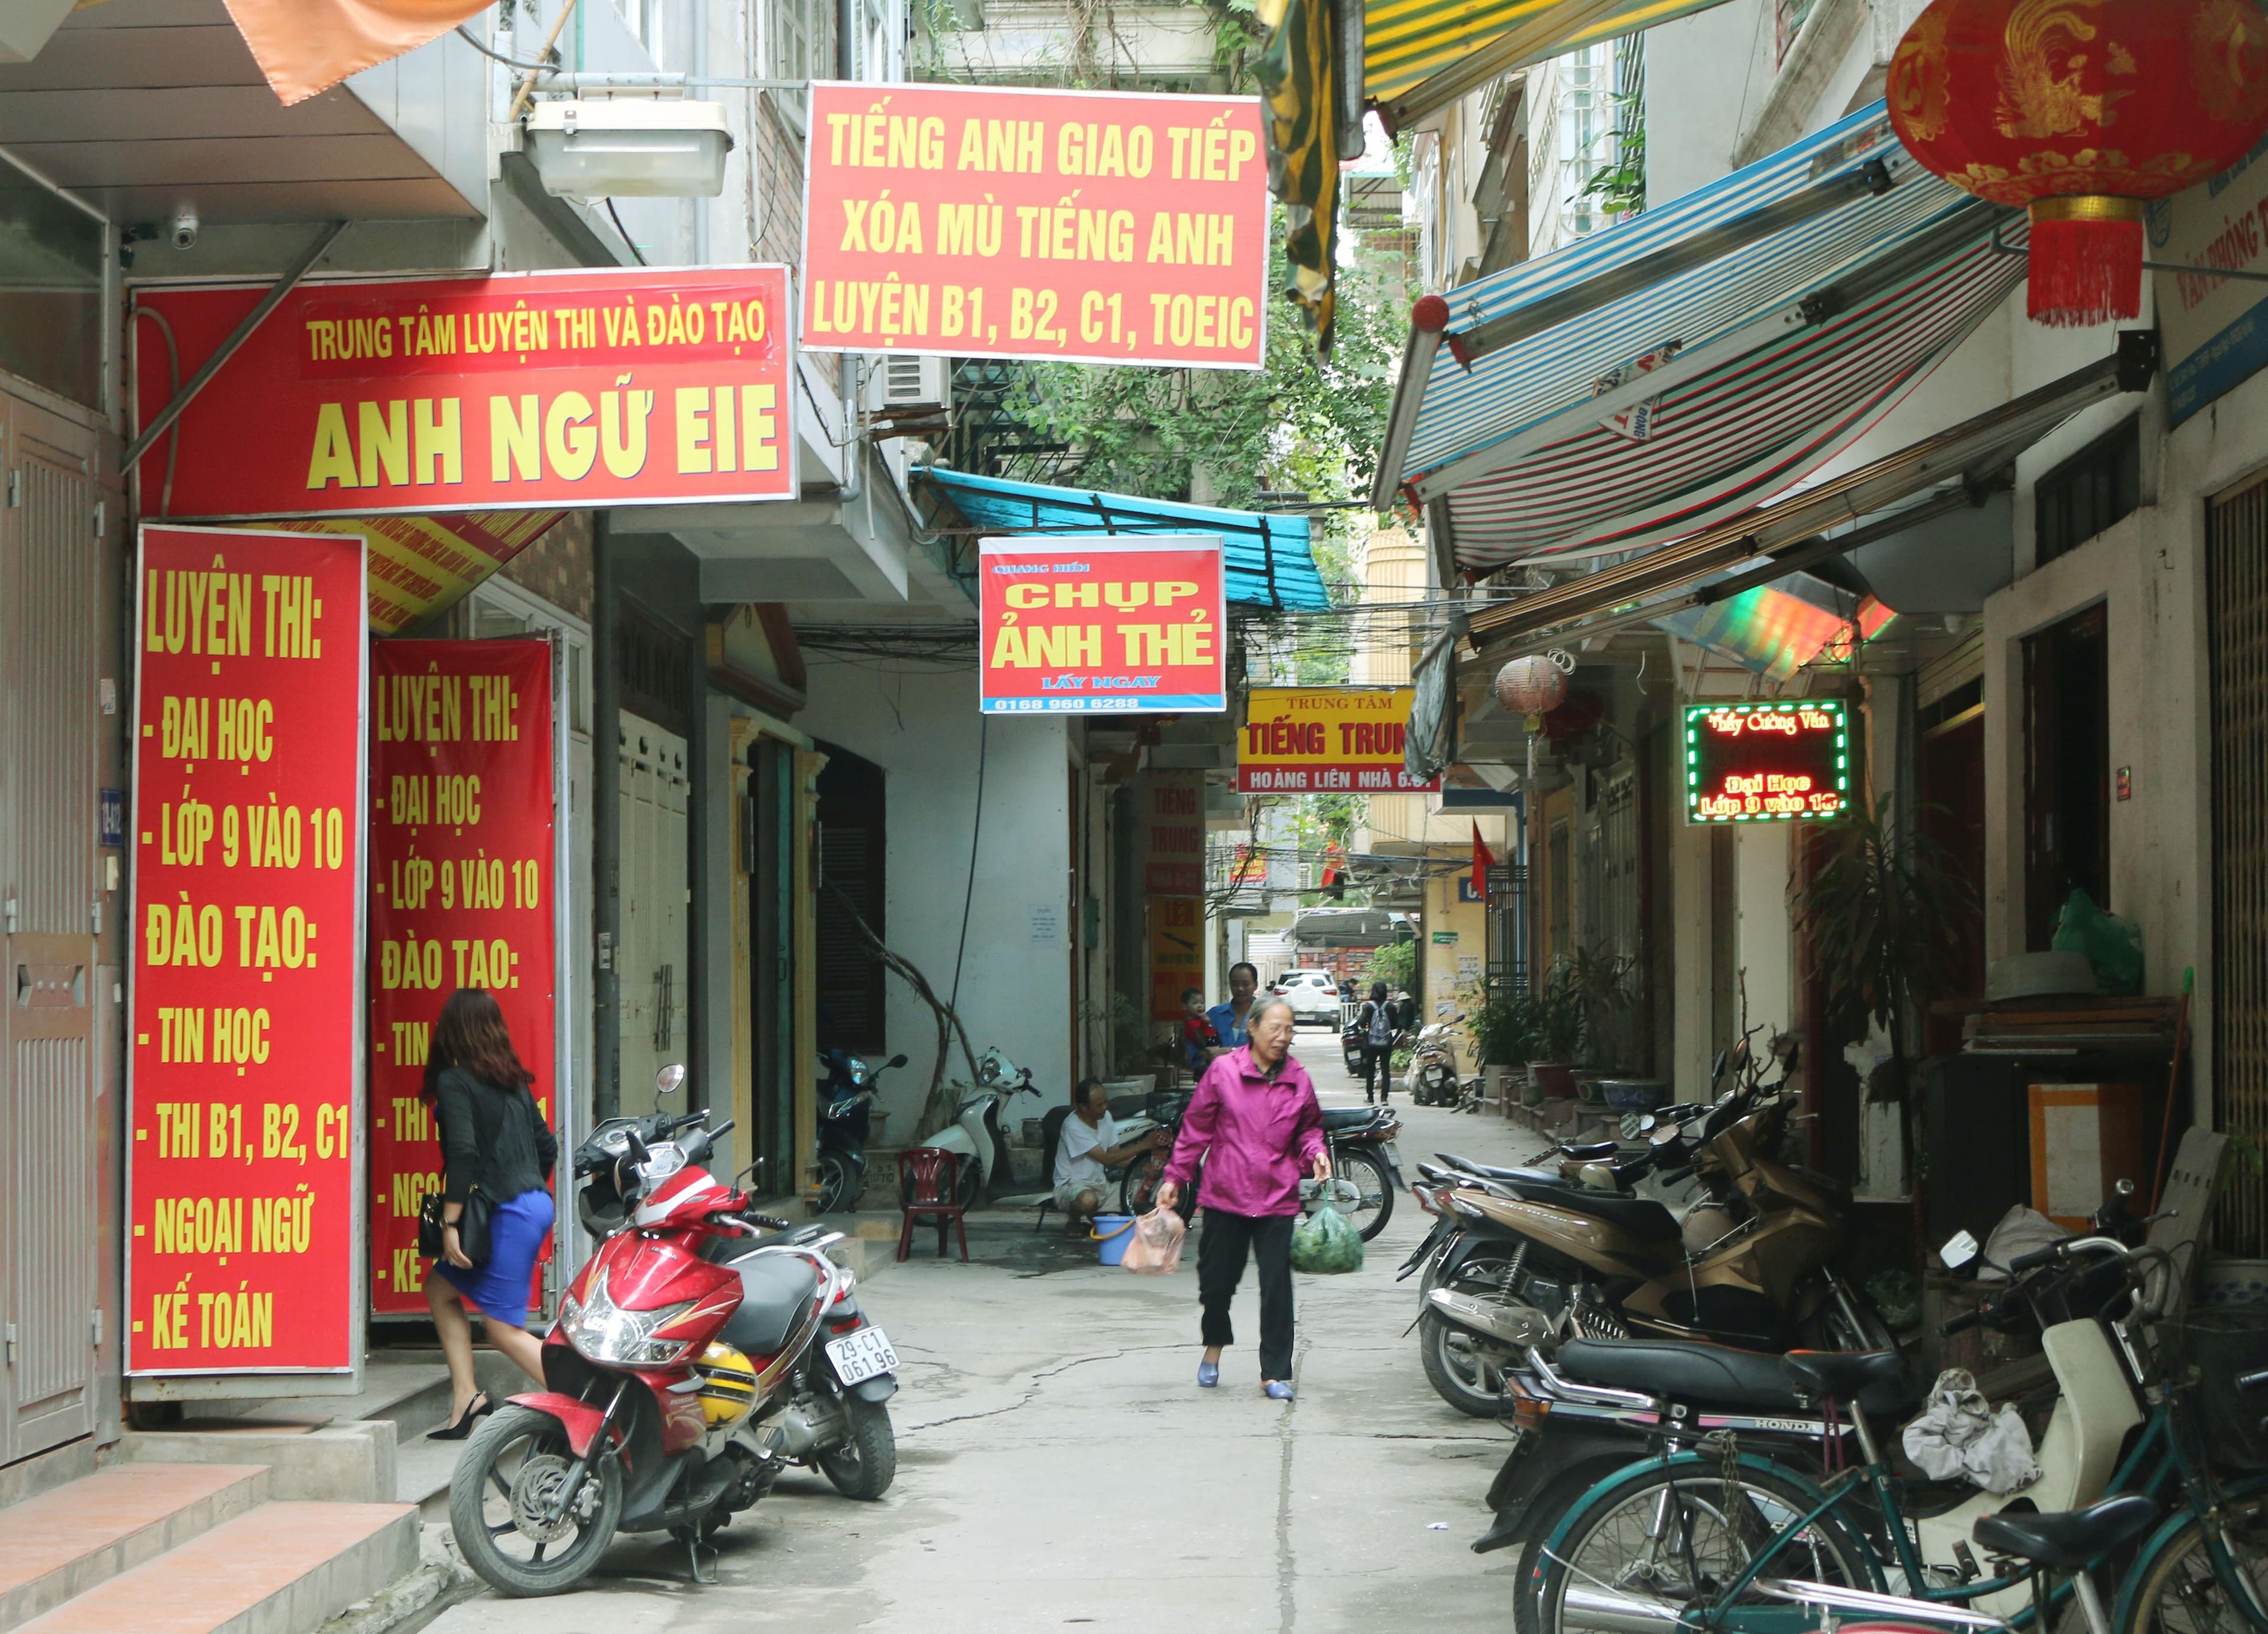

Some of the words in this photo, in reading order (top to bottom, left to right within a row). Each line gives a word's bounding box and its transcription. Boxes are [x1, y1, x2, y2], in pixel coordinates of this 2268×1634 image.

[828, 96, 944, 169] TIẾNG
[958, 119, 1043, 172] ANH
[1058, 123, 1153, 177] GIAO
[1169, 110, 1255, 181] TIẾP
[841, 190, 922, 253] XÓA
[937, 194, 1002, 256] MÙ
[1017, 190, 1134, 261] TIẾNG
[1148, 213, 1233, 265] ANH
[308, 318, 391, 359] TRUNG
[400, 306, 455, 354] TÂM
[465, 301, 547, 363] LUYỆN
[555, 309, 595, 348] THI
[604, 296, 640, 346] VÀ
[647, 294, 704, 344] ĐÀO
[712, 301, 765, 354] TẠO
[814, 272, 928, 345] LUYỆN
[941, 286, 996, 344] B1,
[1011, 289, 1066, 347] B2,
[1081, 291, 1136, 350] C1,
[1151, 294, 1253, 348] TOEIC
[308, 399, 462, 488] ANH
[491, 373, 653, 481] NGỮ
[676, 385, 777, 472] EIE
[992, 565, 1049, 575] QUANG
[1006, 582, 1199, 612] CHỤP
[148, 555, 251, 674] LUYỆN
[263, 576, 321, 658] THI:
[990, 612, 1101, 668] ẢNH
[1117, 609, 1213, 666] THẺ
[378, 661, 461, 757] LUYỆN
[469, 676, 518, 741] THI:
[995, 700, 1043, 709] 0168
[1049, 700, 1084, 709] 960
[1091, 699, 1138, 708] 6288
[1041, 674, 1087, 689] LẤY
[1092, 676, 1162, 689] NGAY
[1287, 699, 1348, 709] TRUNG
[1354, 696, 1392, 709] TÂM
[163, 697, 208, 772] ĐẠI
[219, 699, 272, 774] HỌC
[1247, 715, 1325, 755] TIẾNG
[1339, 723, 1407, 754] TRUN
[391, 775, 428, 836] ĐẠI
[436, 775, 481, 836] HỌC
[1314, 768, 1350, 788] LIÊN
[1358, 768, 1392, 787] NHÀ
[1701, 793, 1742, 815] Lớp
[1745, 797, 1760, 813] 9
[1764, 794, 1804, 811] vào
[1725, 774, 1763, 796] Đại
[163, 785, 213, 865] LỚP
[223, 805, 238, 866] 9
[248, 793, 300, 867] VÀO
[312, 808, 342, 869] 10
[1151, 826, 1198, 853] TRUNG
[392, 844, 434, 909] LỚP
[441, 859, 454, 909] 9
[461, 849, 504, 909] VÀO
[512, 859, 539, 909] 10
[146, 892, 222, 966] ĐÀO
[236, 906, 316, 981] TẠO:
[381, 929, 442, 989] ĐÀO
[159, 1008, 203, 1062] TIN
[214, 1009, 269, 1075] HỌC
[392, 1022, 428, 1066] TIN
[157, 1104, 200, 1157] THI
[210, 1104, 252, 1163] B1,
[264, 1104, 306, 1164] B2,
[317, 1104, 347, 1158] C1
[392, 1098, 427, 1141] THI
[155, 1198, 242, 1265] NGOẠI
[253, 1185, 314, 1253] NGỮ
[154, 1274, 191, 1348] KẾ
[198, 1281, 272, 1347] TOÁN
[836, 1332, 882, 1361] 29-C1
[842, 1349, 897, 1381] 061.96
[1754, 1419, 1819, 1433] HONDA
